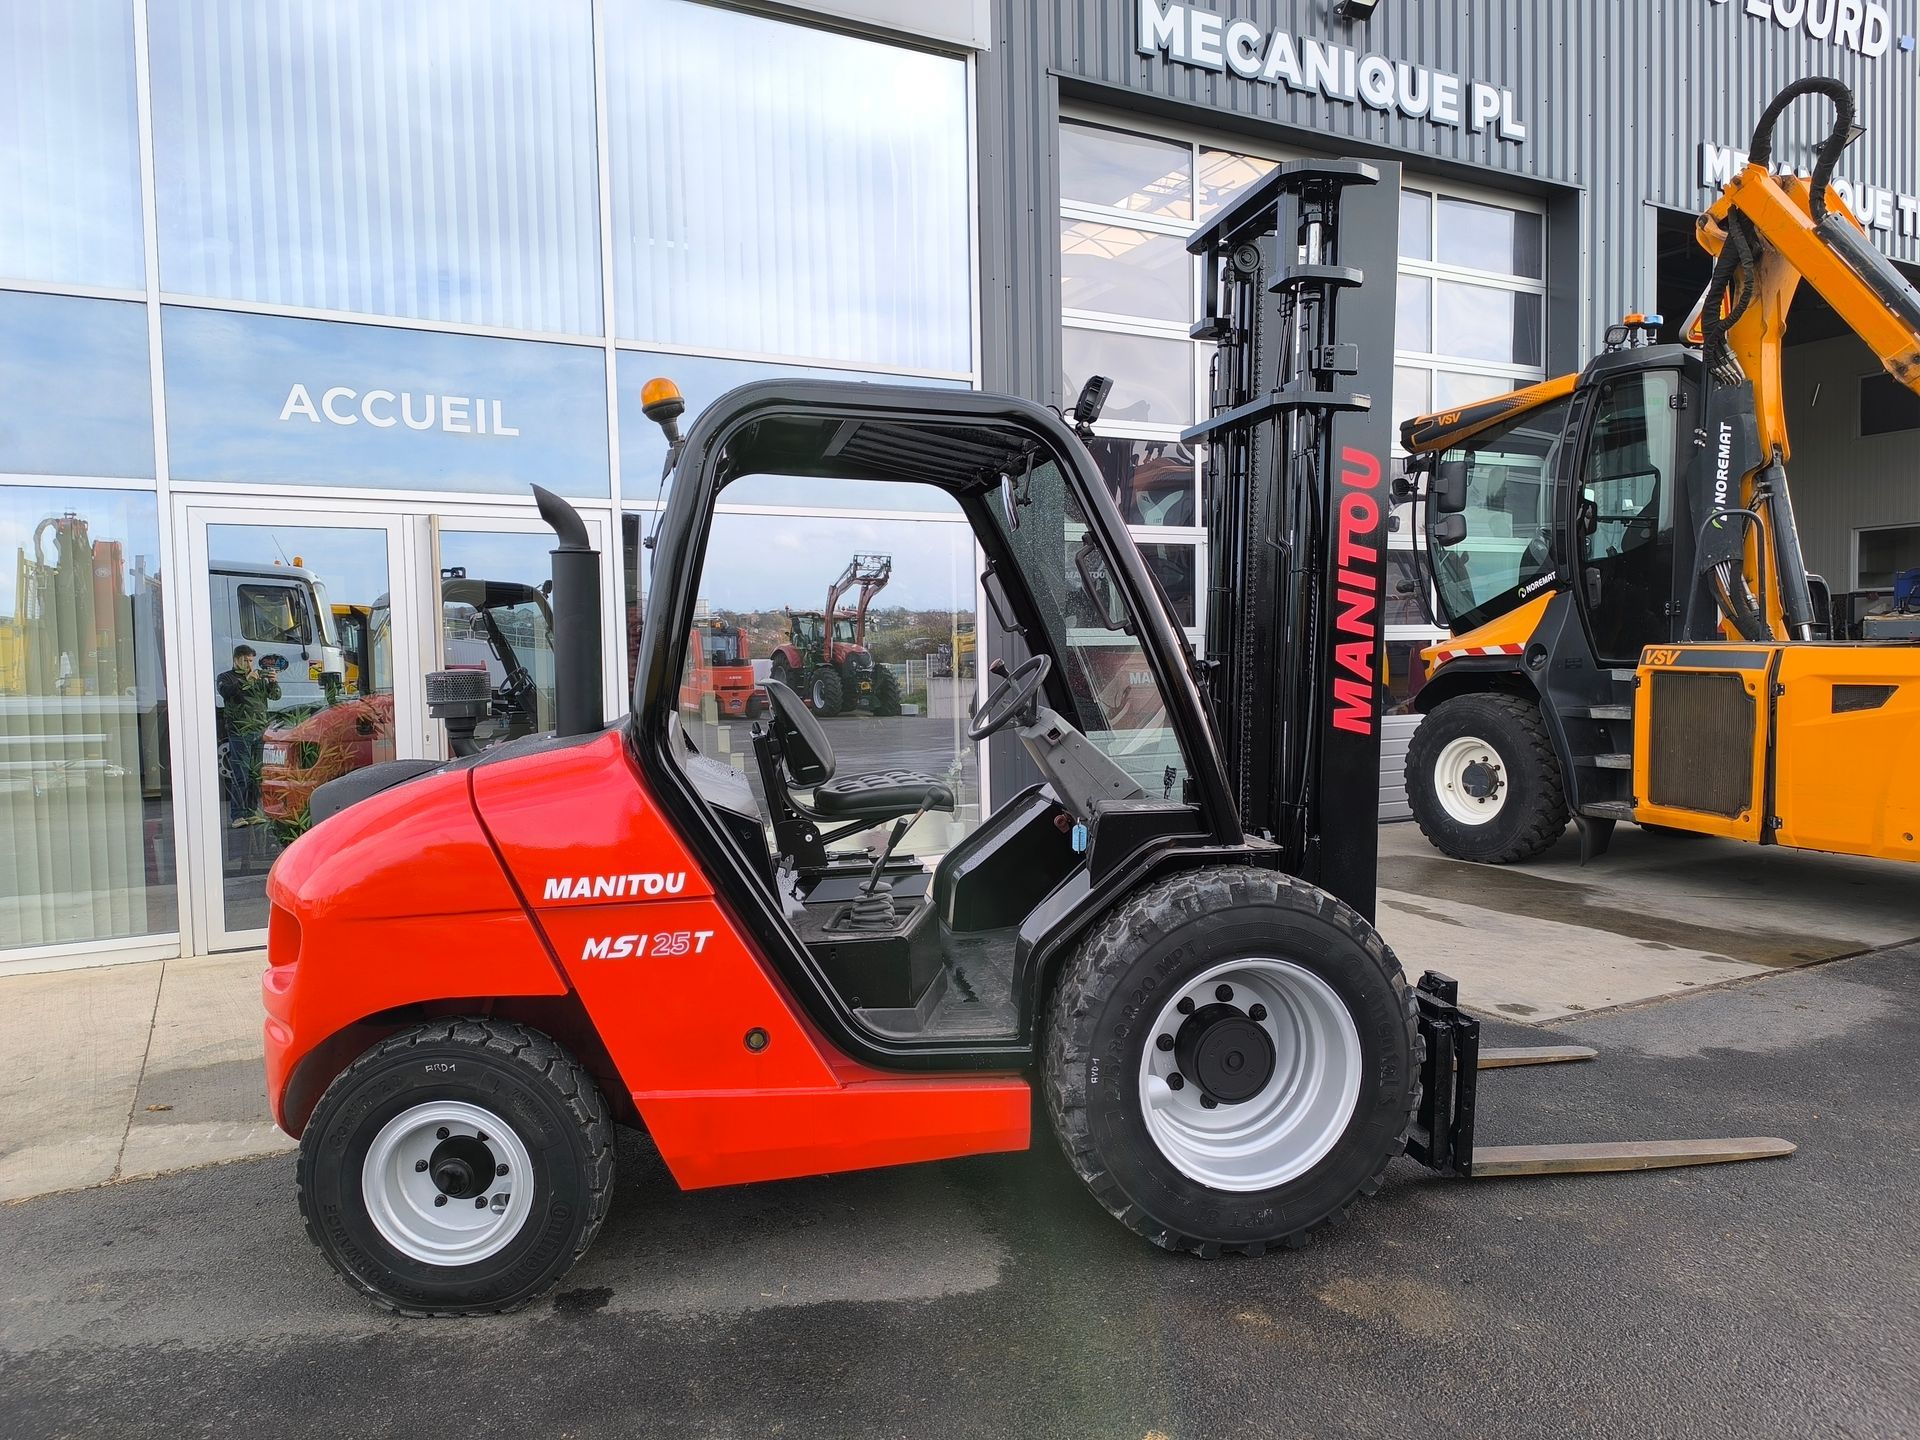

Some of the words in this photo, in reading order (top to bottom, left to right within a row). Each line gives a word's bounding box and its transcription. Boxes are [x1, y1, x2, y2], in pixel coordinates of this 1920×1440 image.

[1745, 0, 1891, 58] OURD
[1140, 0, 1460, 125] MECANIQUE
[1473, 80, 1527, 139] PL
[279, 383, 521, 437] ACCUEIL
[1438, 411, 1462, 426] VSV
[1714, 421, 1732, 504] NOREMAT
[1065, 571, 1105, 579] MATOU
[1525, 571, 1556, 594] NOREMAT
[1333, 446, 1382, 736] MANITOU
[1645, 649, 1681, 665] VSV
[543, 872, 686, 900] MANITOU
[581, 934, 648, 960] MSI
[651, 931, 690, 957] 25
[694, 931, 714, 954] T
